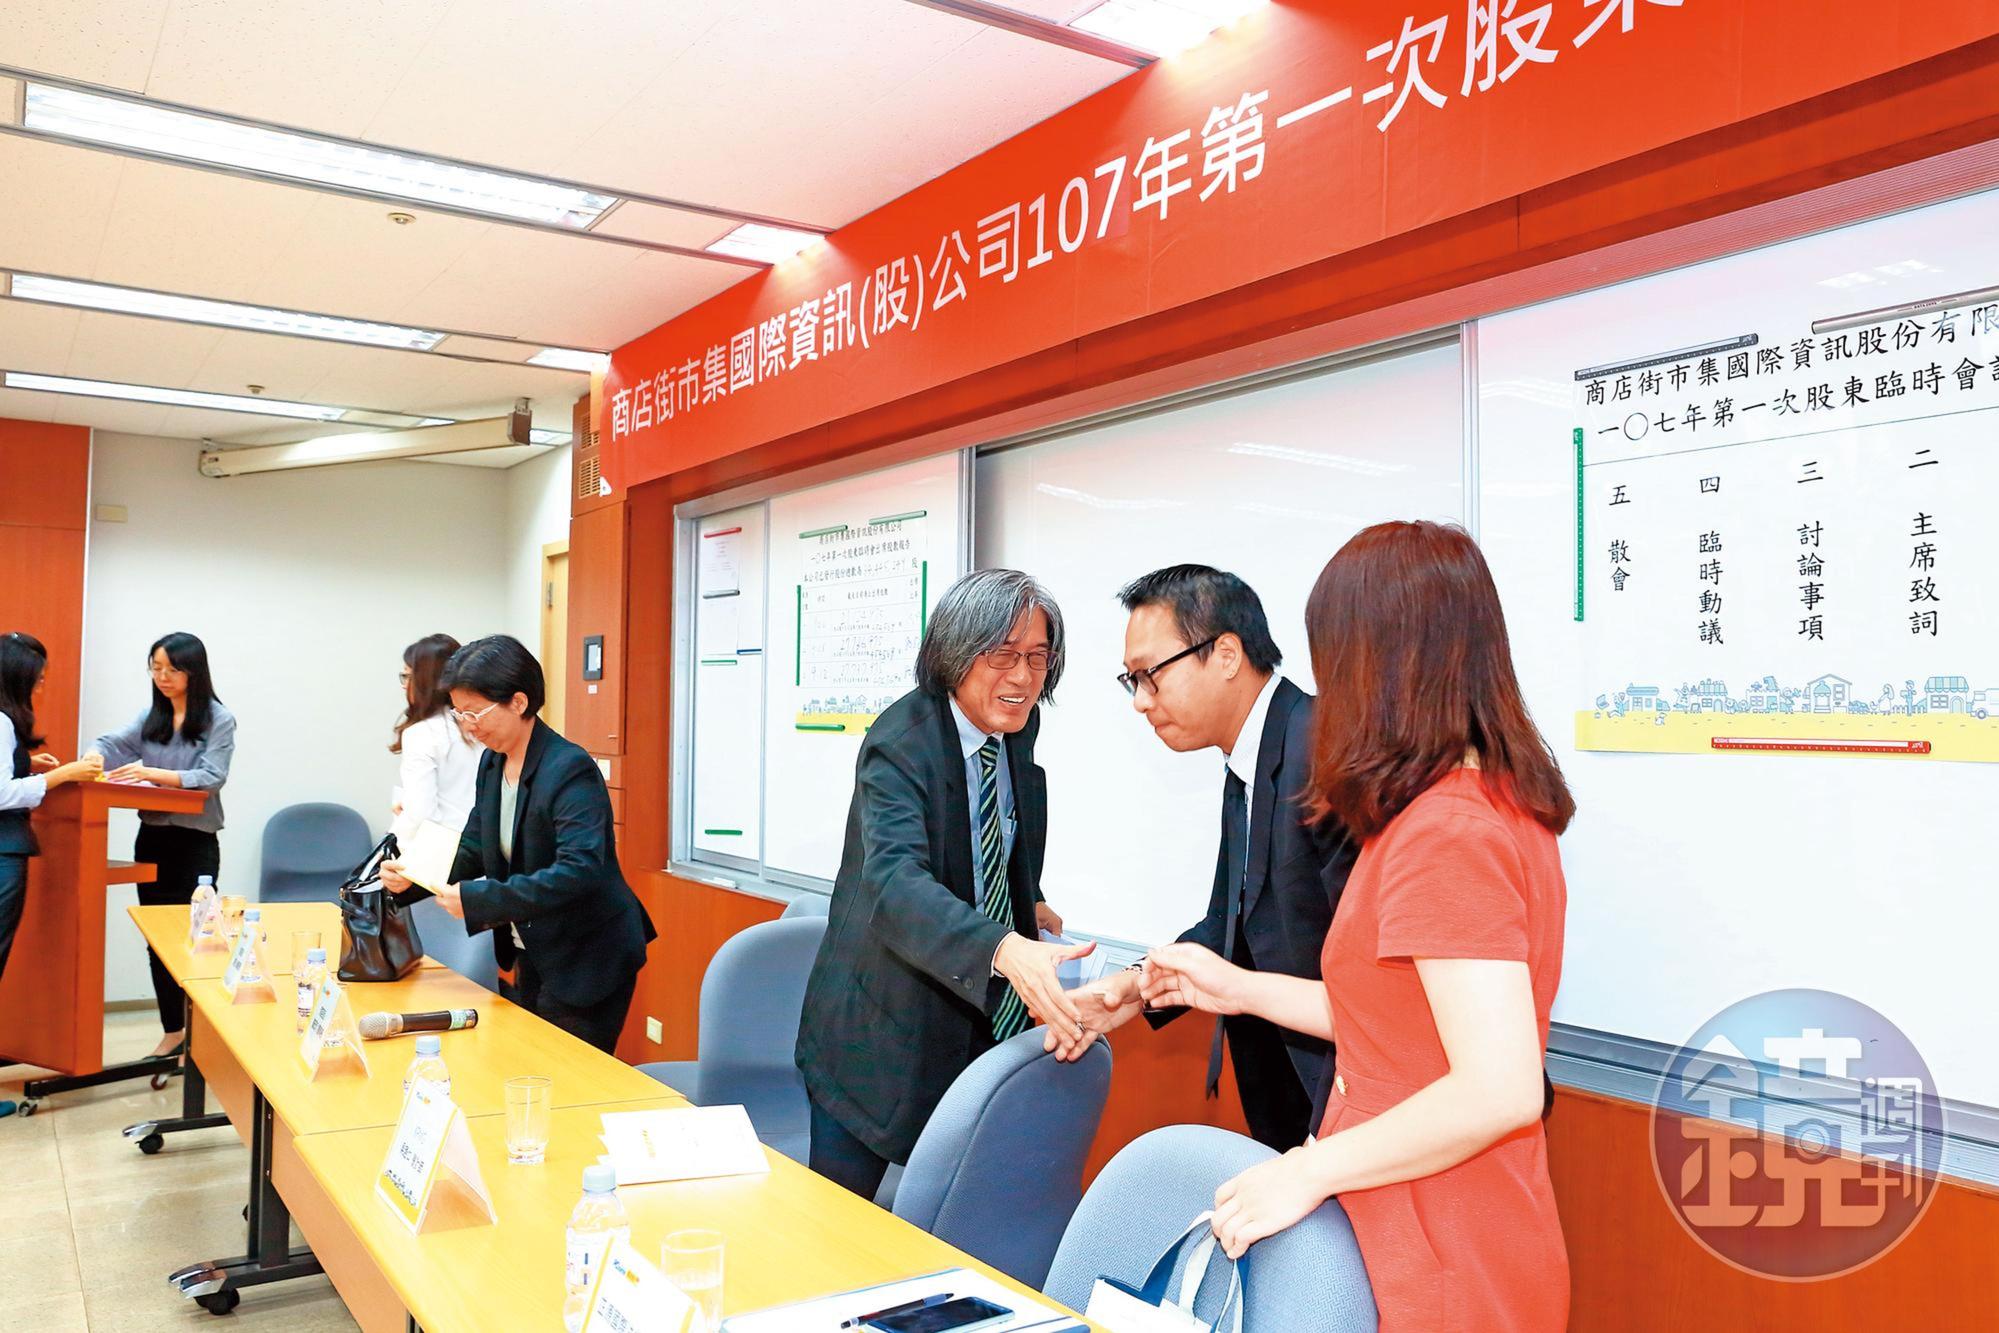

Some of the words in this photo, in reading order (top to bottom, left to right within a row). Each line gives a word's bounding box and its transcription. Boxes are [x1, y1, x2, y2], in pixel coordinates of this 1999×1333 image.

[612, 0, 1685, 442] 商店街市集國際資訊(股)公司107年第一次股
[1584, 303, 1999, 407] 商店街市集國際資訊股份有限
[1608, 484, 1631, 506] 五
[1699, 476, 1721, 494] 四
[1797, 461, 1824, 484] 三
[1908, 449, 1939, 469] 二
[1607, 539, 1632, 592] 散會
[1698, 530, 1724, 645] 臨時動議
[1796, 520, 1825, 641] 討論事項
[1908, 512, 1940, 637] 主席致詞
